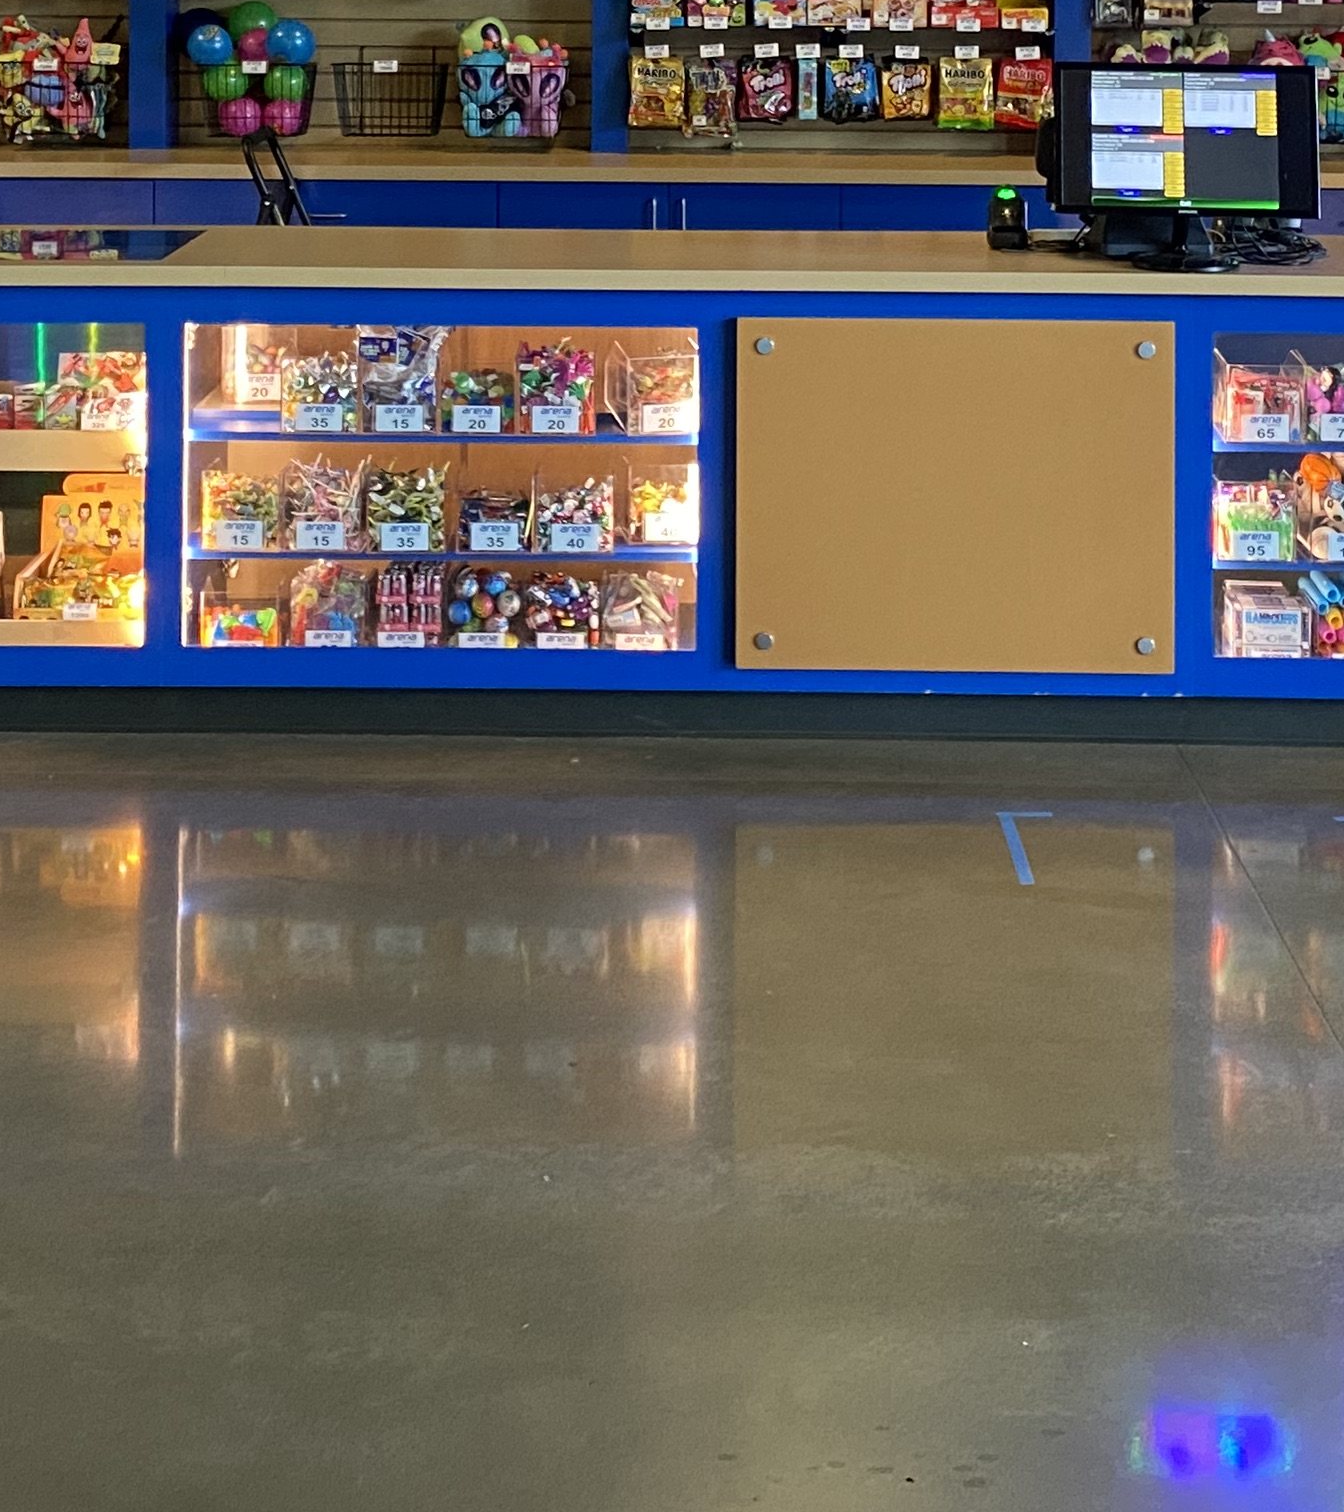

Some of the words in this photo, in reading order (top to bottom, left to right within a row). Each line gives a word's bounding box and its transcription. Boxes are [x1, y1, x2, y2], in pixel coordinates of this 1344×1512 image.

[637, 67, 676, 78] HARIBO
[945, 69, 985, 79] HARIBO
[1004, 66, 1047, 82] HARIBO
[251, 387, 269, 398] 20
[304, 405, 335, 414] arena
[384, 405, 416, 414] arena
[462, 406, 493, 415] arena
[540, 406, 572, 415] arena
[311, 417, 329, 428] 35
[392, 419, 409, 429] 15
[468, 419, 486, 429] 20
[547, 419, 565, 430] 20
[658, 418, 675, 429] 20
[1249, 415, 1282, 424] arena
[1256, 428, 1275, 439] 65
[224, 521, 256, 530] arena
[305, 523, 336, 532] arena
[389, 524, 422, 533] arena
[479, 524, 511, 533] arena
[560, 524, 592, 534] arena
[232, 535, 249, 545] 15
[312, 536, 329, 546] 15
[396, 537, 415, 548] 35
[486, 537, 504, 548] 35
[1239, 533, 1272, 542] arena
[566, 538, 585, 549] 40
[1246, 545, 1266, 556] 95
[1245, 612, 1299, 626] HANDCUFFS
[313, 632, 344, 640] arena
[385, 634, 417, 642] arena
[467, 634, 498, 642] arena
[545, 634, 577, 643] arena
[624, 635, 655, 644] arena
